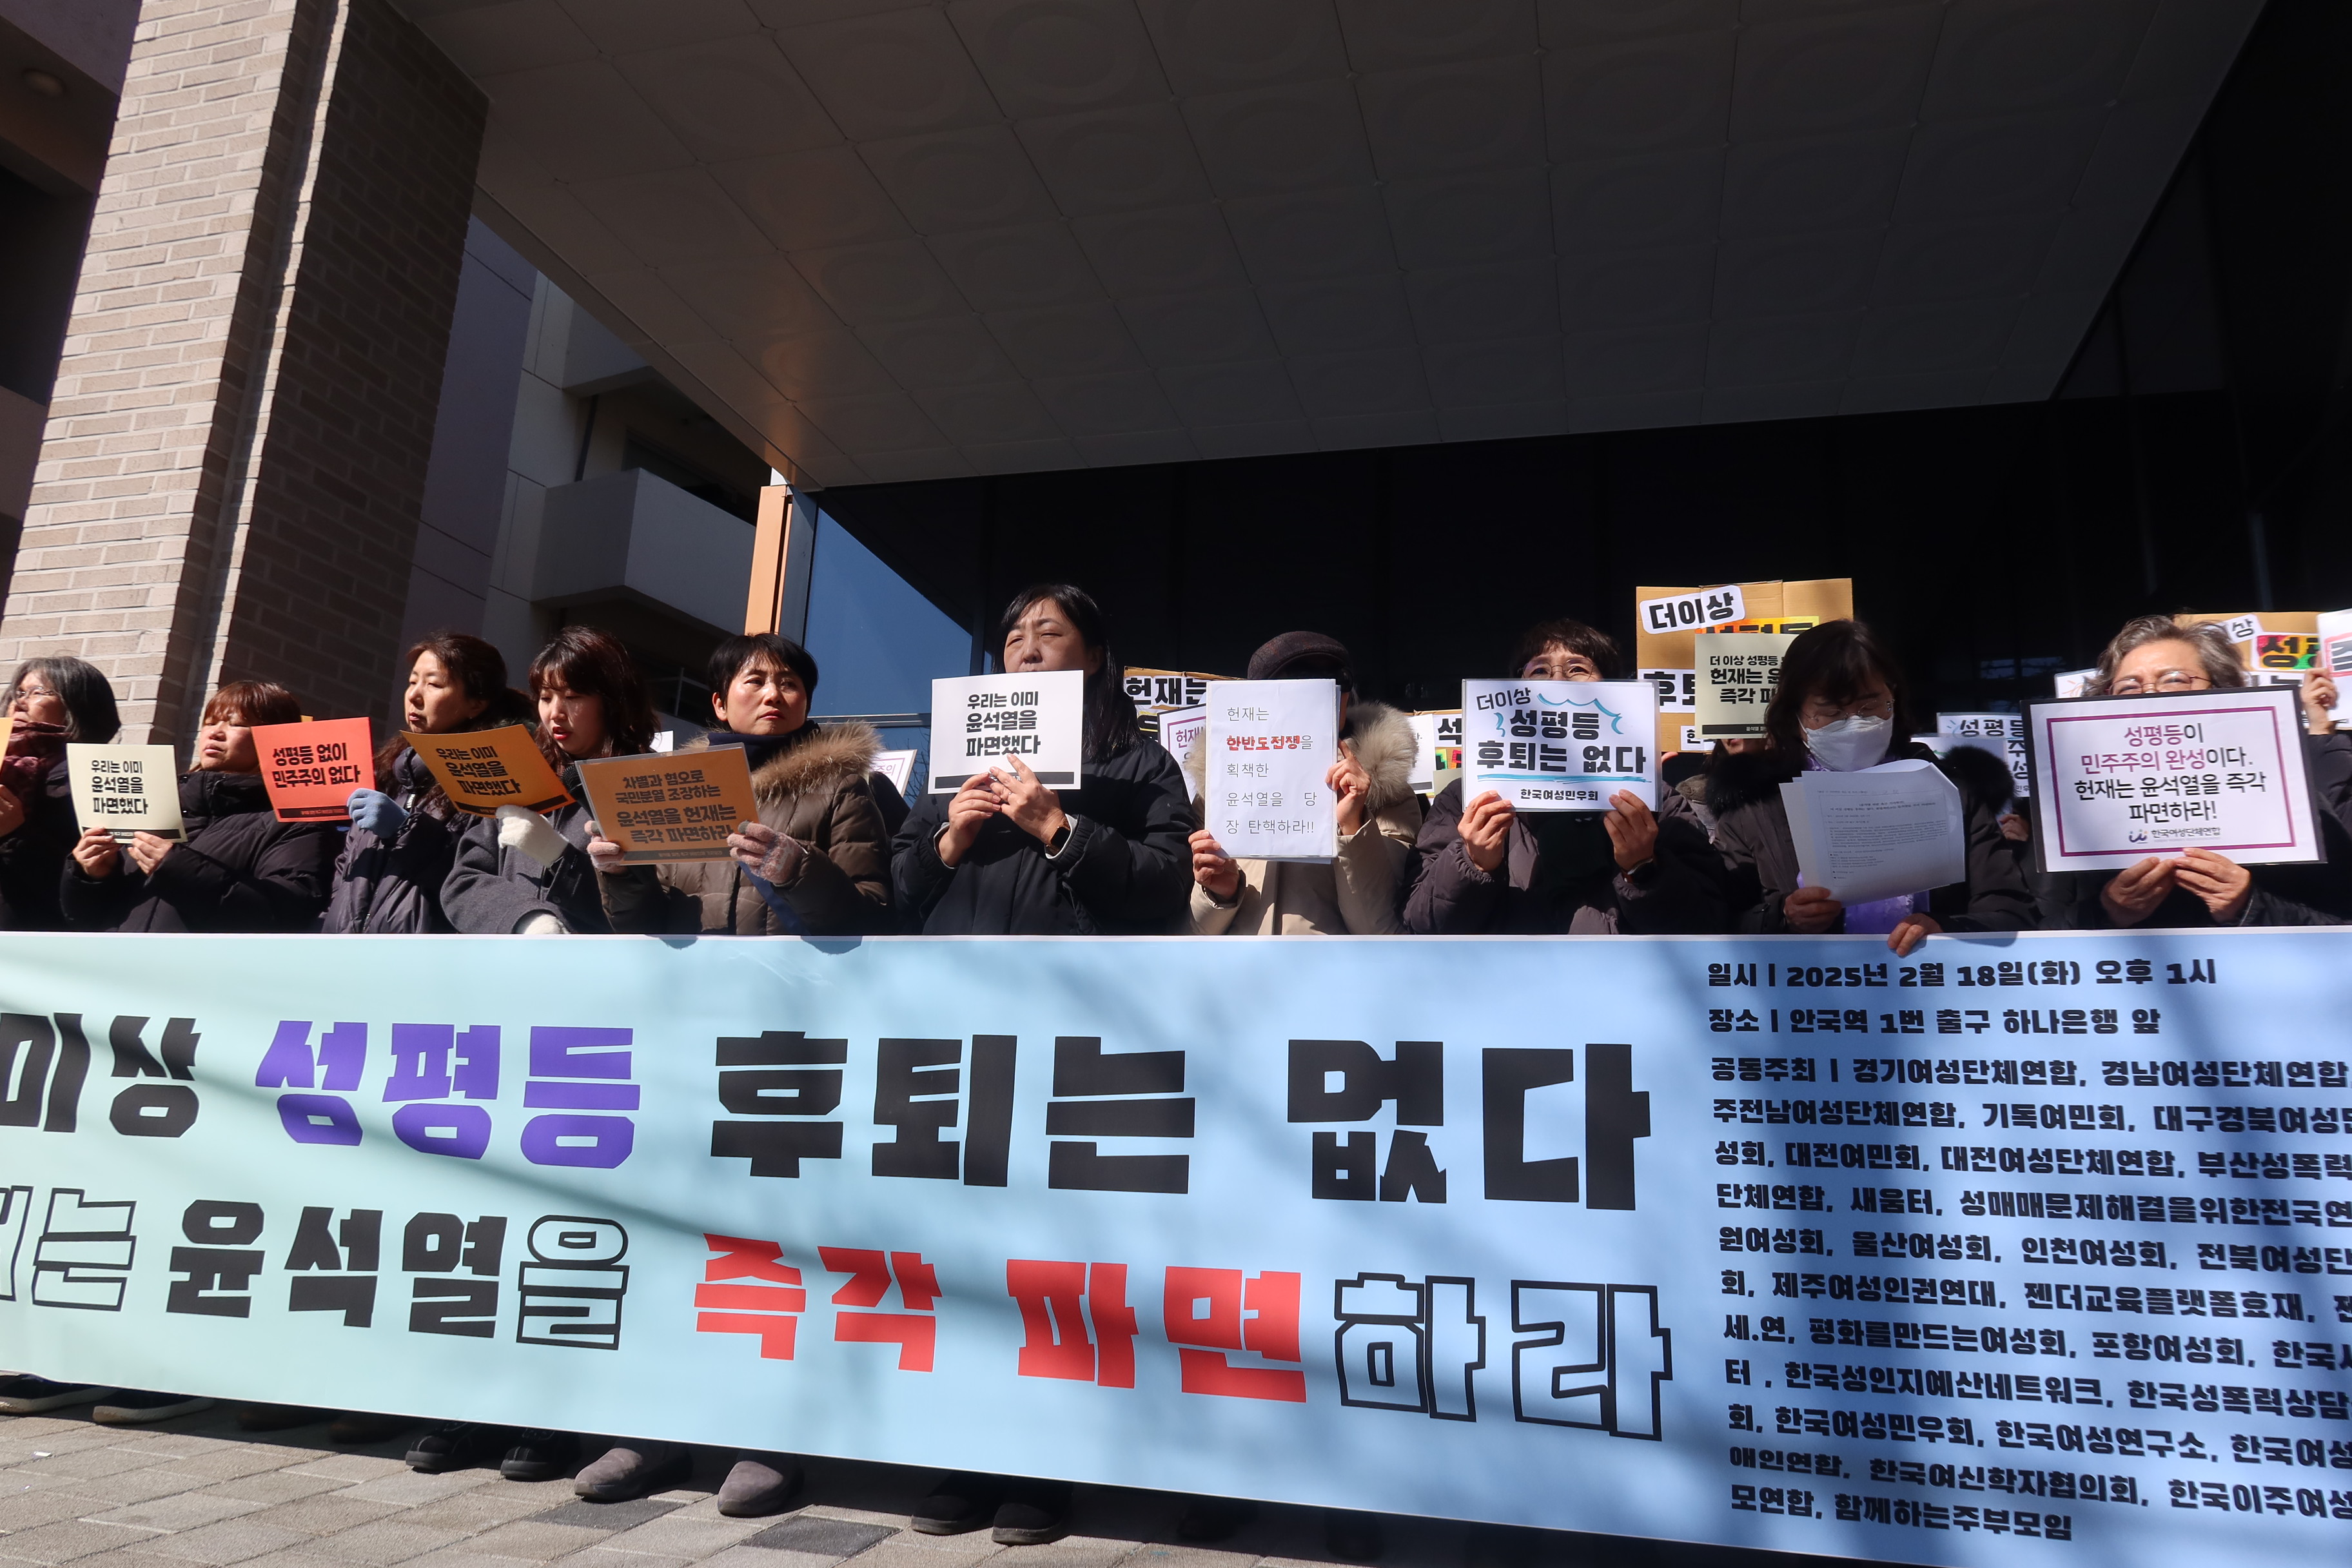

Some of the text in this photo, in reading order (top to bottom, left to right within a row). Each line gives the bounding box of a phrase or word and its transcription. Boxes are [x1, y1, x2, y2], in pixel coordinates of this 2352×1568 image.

[1649, 592, 1734, 629] 더이상
[1710, 656, 1720, 666] 더
[1723, 655, 1744, 665] 이상
[1747, 655, 1778, 666] 성평등
[1710, 668, 1763, 685] 헌재는
[967, 691, 1039, 710] 우리는 이미
[1126, 678, 1206, 705] 헌재는
[1476, 687, 1532, 711] 더이상
[1720, 688, 1756, 704] 즉각
[966, 710, 1037, 733] 윤석열을
[1227, 707, 1269, 721] 헌재는
[1509, 709, 1600, 740] 성평등
[966, 734, 1041, 757] 파면했다
[1226, 734, 1313, 750] 한반도전쟁을
[2124, 723, 2204, 747] 성평등이
[272, 742, 348, 767] 성평등 없이
[436, 745, 498, 760] 우리는 이미
[1476, 740, 1567, 773] 후퇴는
[1583, 745, 1646, 774] 없다
[2081, 746, 2253, 775] 민주주의 완성이다.
[91, 760, 143, 774] 우리는 이미
[272, 765, 360, 789] 민주주의 없다
[445, 760, 508, 778] 윤석열을
[623, 769, 705, 789] 차별과 혐오로
[1227, 763, 1269, 778] 획책한
[92, 776, 144, 794] 윤석열을
[456, 779, 522, 796] 파면했다
[615, 784, 721, 805] 국민분열 조장하는
[1520, 788, 1598, 801] 한국여성민우회
[2074, 772, 2267, 801] 헌재는 윤석열을 즉각
[93, 798, 148, 814] 파면했다
[1226, 792, 1317, 807] 윤석열을 당
[616, 805, 737, 827] 윤석열을 헌재는
[2129, 802, 2217, 825] 파면하라!
[630, 825, 734, 844] 즉각 파면하라
[1226, 819, 1314, 834] 장 탄핵하라!!
[2151, 827, 2220, 838] 한국여성단체연합
[1708, 963, 1756, 986] 일시
[1787, 963, 1888, 987] 2025년
[1899, 963, 1944, 986] 2월
[1957, 961, 2081, 986] 18일(화)
[2095, 959, 2153, 985] 오후
[2166, 959, 2217, 985] 1시
[1709, 1009, 1759, 1033] 장소
[1790, 1009, 1868, 1033] 안국역
[1880, 1010, 1925, 1034] 1번
[1936, 1009, 1990, 1034] 출구
[2003, 1009, 2119, 1034] 하나은행
[2132, 1008, 2161, 1034] 앞
[1712, 1057, 1815, 1082] 공동주최
[1853, 1059, 2086, 1087] 경기여성단체연합,
[255, 1020, 640, 1170] 성평등
[710, 1030, 1196, 1194] 후퇴는
[1287, 1039, 1651, 1211] 없다
[1713, 1099, 1965, 1128] 주전남여성단체연합,
[1983, 1103, 2135, 1132] 기독여민회,
[1715, 1141, 2352, 1181] 성회, 대전여민회, 대전여성단체연합, 부산성폭력
[1717, 1184, 2352, 1228] 단체연합, 새움터, 성매매문제해결을위한전국연
[1720, 1227, 1833, 1257] 원여성회,
[1852, 1231, 2001, 1263] 울산여성회,
[2022, 1237, 2177, 1269] 인천여성회,
[1721, 1269, 1754, 1297] 회,
[1772, 1272, 2006, 1309] 제주여성인권연대,
[2024, 1282, 2315, 1323] 젠더교육플랫폼효재,
[166, 1199, 629, 1351] 윤석열을
[694, 1233, 943, 1373] 즉각
[1006, 1258, 1673, 1443] 파면하라
[1723, 1315, 1795, 1344] 세.연,
[1809, 1318, 2076, 1358] 평화를만드는여성회,
[2092, 1332, 2255, 1367] 포항여성회,
[1725, 1359, 1750, 1385] 터
[1785, 1362, 2113, 1408] 한국성인지예산네트워크,
[2128, 1380, 2352, 1420] 한국성폭력상담
[1728, 1404, 2352, 1469] 회, 한국여성민우회, 한국여성연구소, 한국여성
[1730, 1446, 2352, 1520] 애인연합, 한국여신학자협의회, 한국이주여성
[1731, 1484, 2072, 1541] 모연합, 함께하는주부모임
